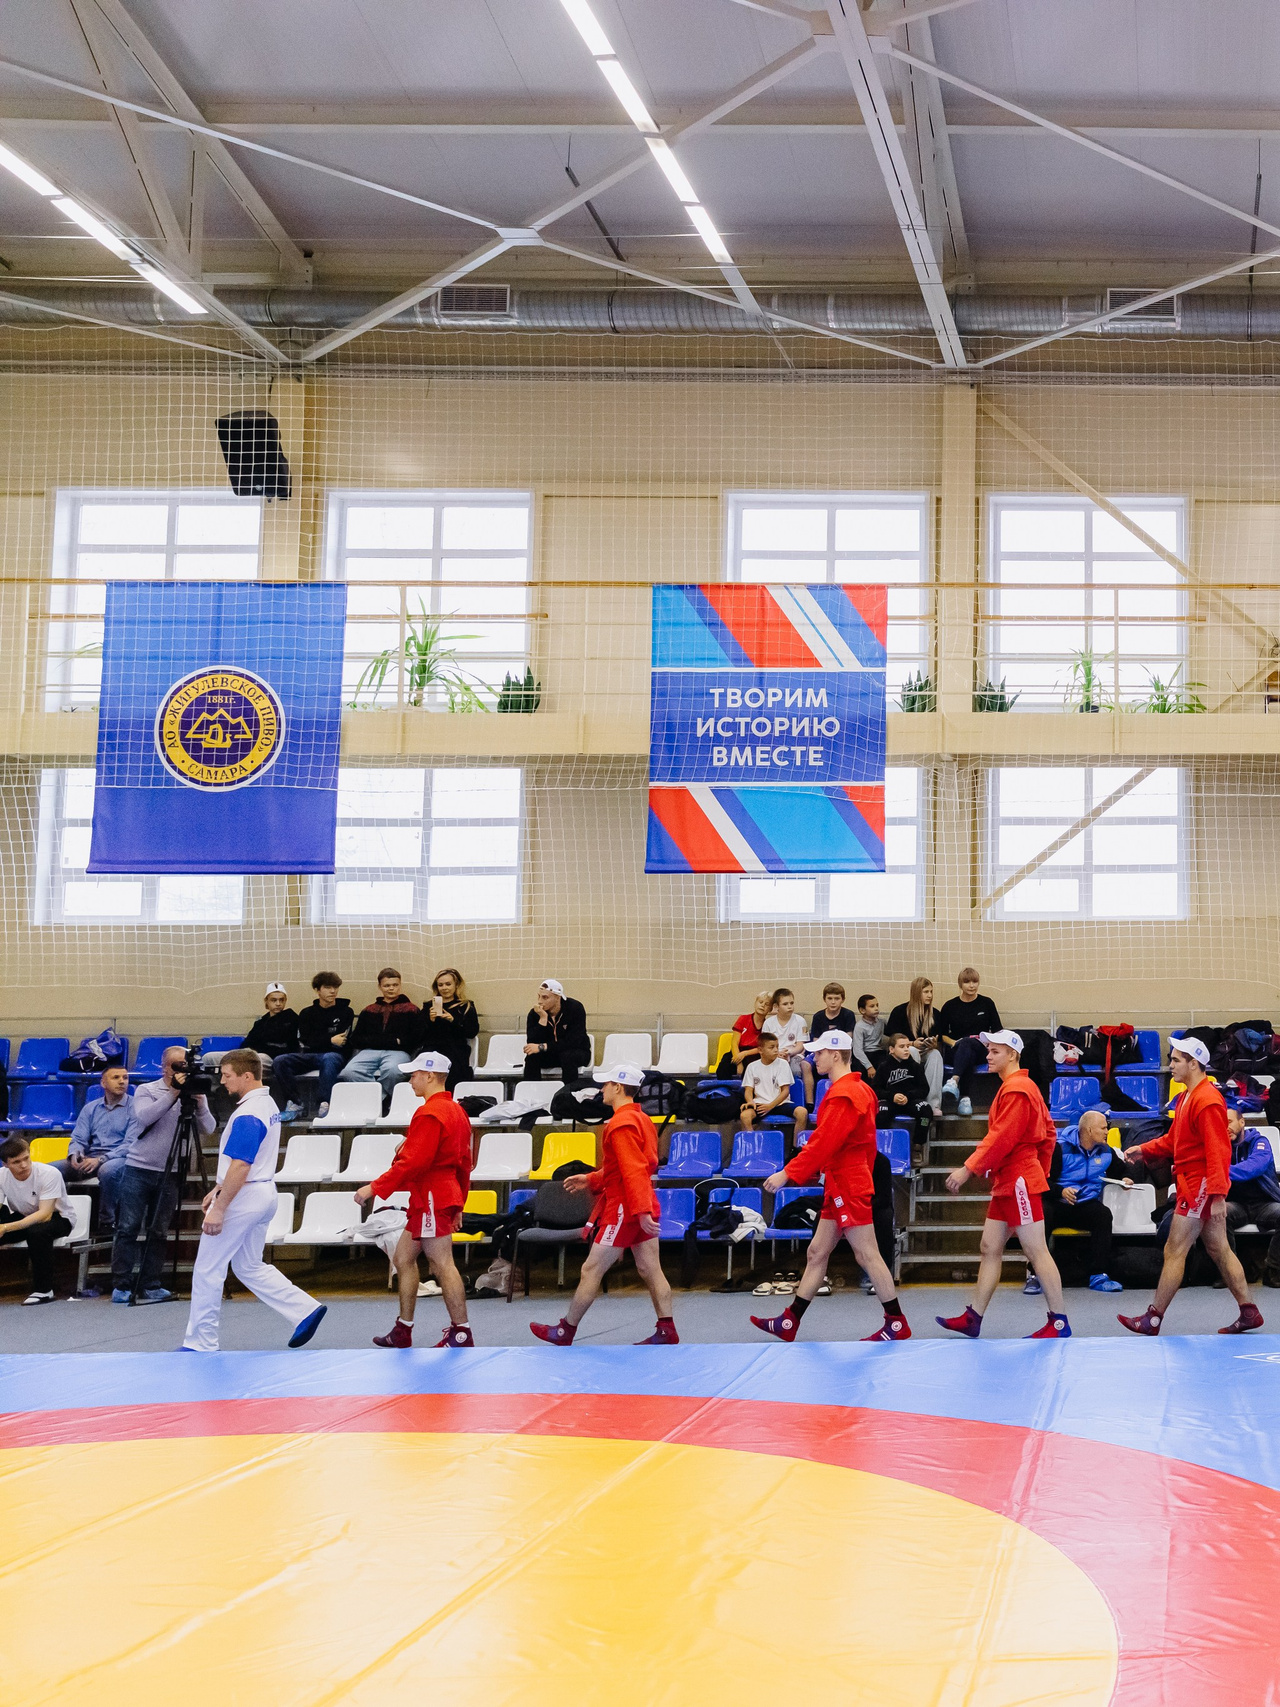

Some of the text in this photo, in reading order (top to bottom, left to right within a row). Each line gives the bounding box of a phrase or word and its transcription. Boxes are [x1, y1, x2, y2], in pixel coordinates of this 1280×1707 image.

[207, 695, 236, 704] 1881г.
[709, 687, 828, 708] ТВОРИМ
[165, 676, 276, 752] АО «ЖИГУЛЕВСКОЕ ПИВО»
[696, 716, 841, 738] ИСТОРИЮ
[712, 746, 824, 767] ВМЕСТЕ
[187, 763, 248, 781] САМАРА
